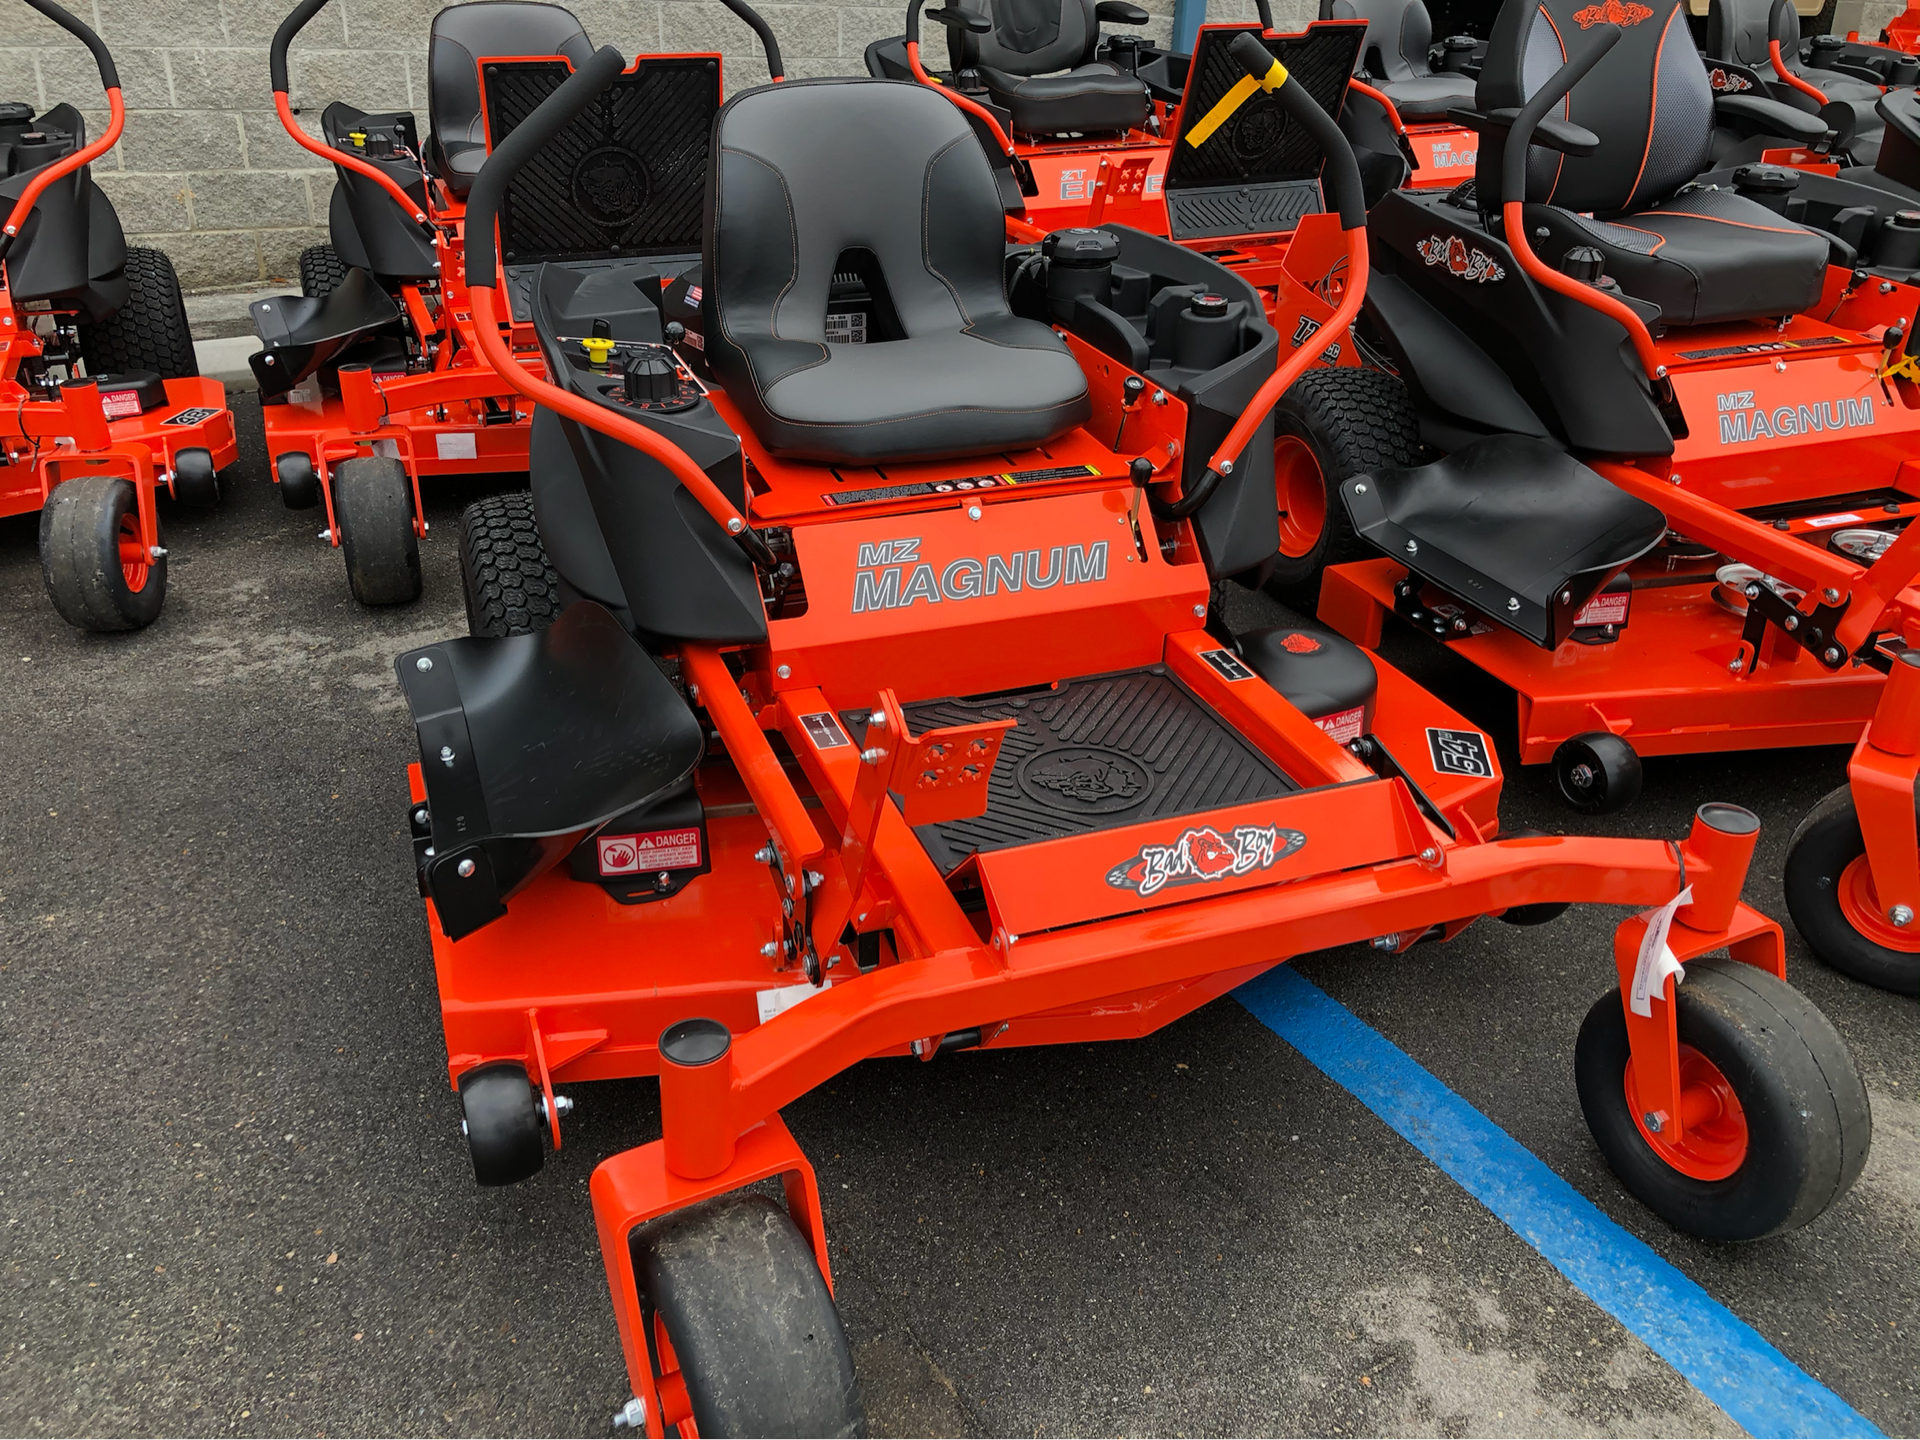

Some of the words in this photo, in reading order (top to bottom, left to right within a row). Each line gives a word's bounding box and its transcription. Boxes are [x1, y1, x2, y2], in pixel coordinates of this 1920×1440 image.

[1432, 142, 1451, 152] MZ
[1433, 150, 1478, 168] MAG
[1061, 169, 1087, 181] ZT
[111, 392, 137, 402] DANGER
[1717, 391, 1755, 412] MZ
[1719, 397, 1875, 445] MAGNUM
[857, 537, 922, 568] MZ
[852, 540, 1109, 614] MAGNUM
[1600, 596, 1627, 607] DANGER
[1335, 710, 1362, 728] DANGER
[1438, 737, 1485, 776] 54
[656, 833, 696, 847] DANGER
[1139, 839, 1187, 895] Bad
[1233, 826, 1276, 873] Boy
